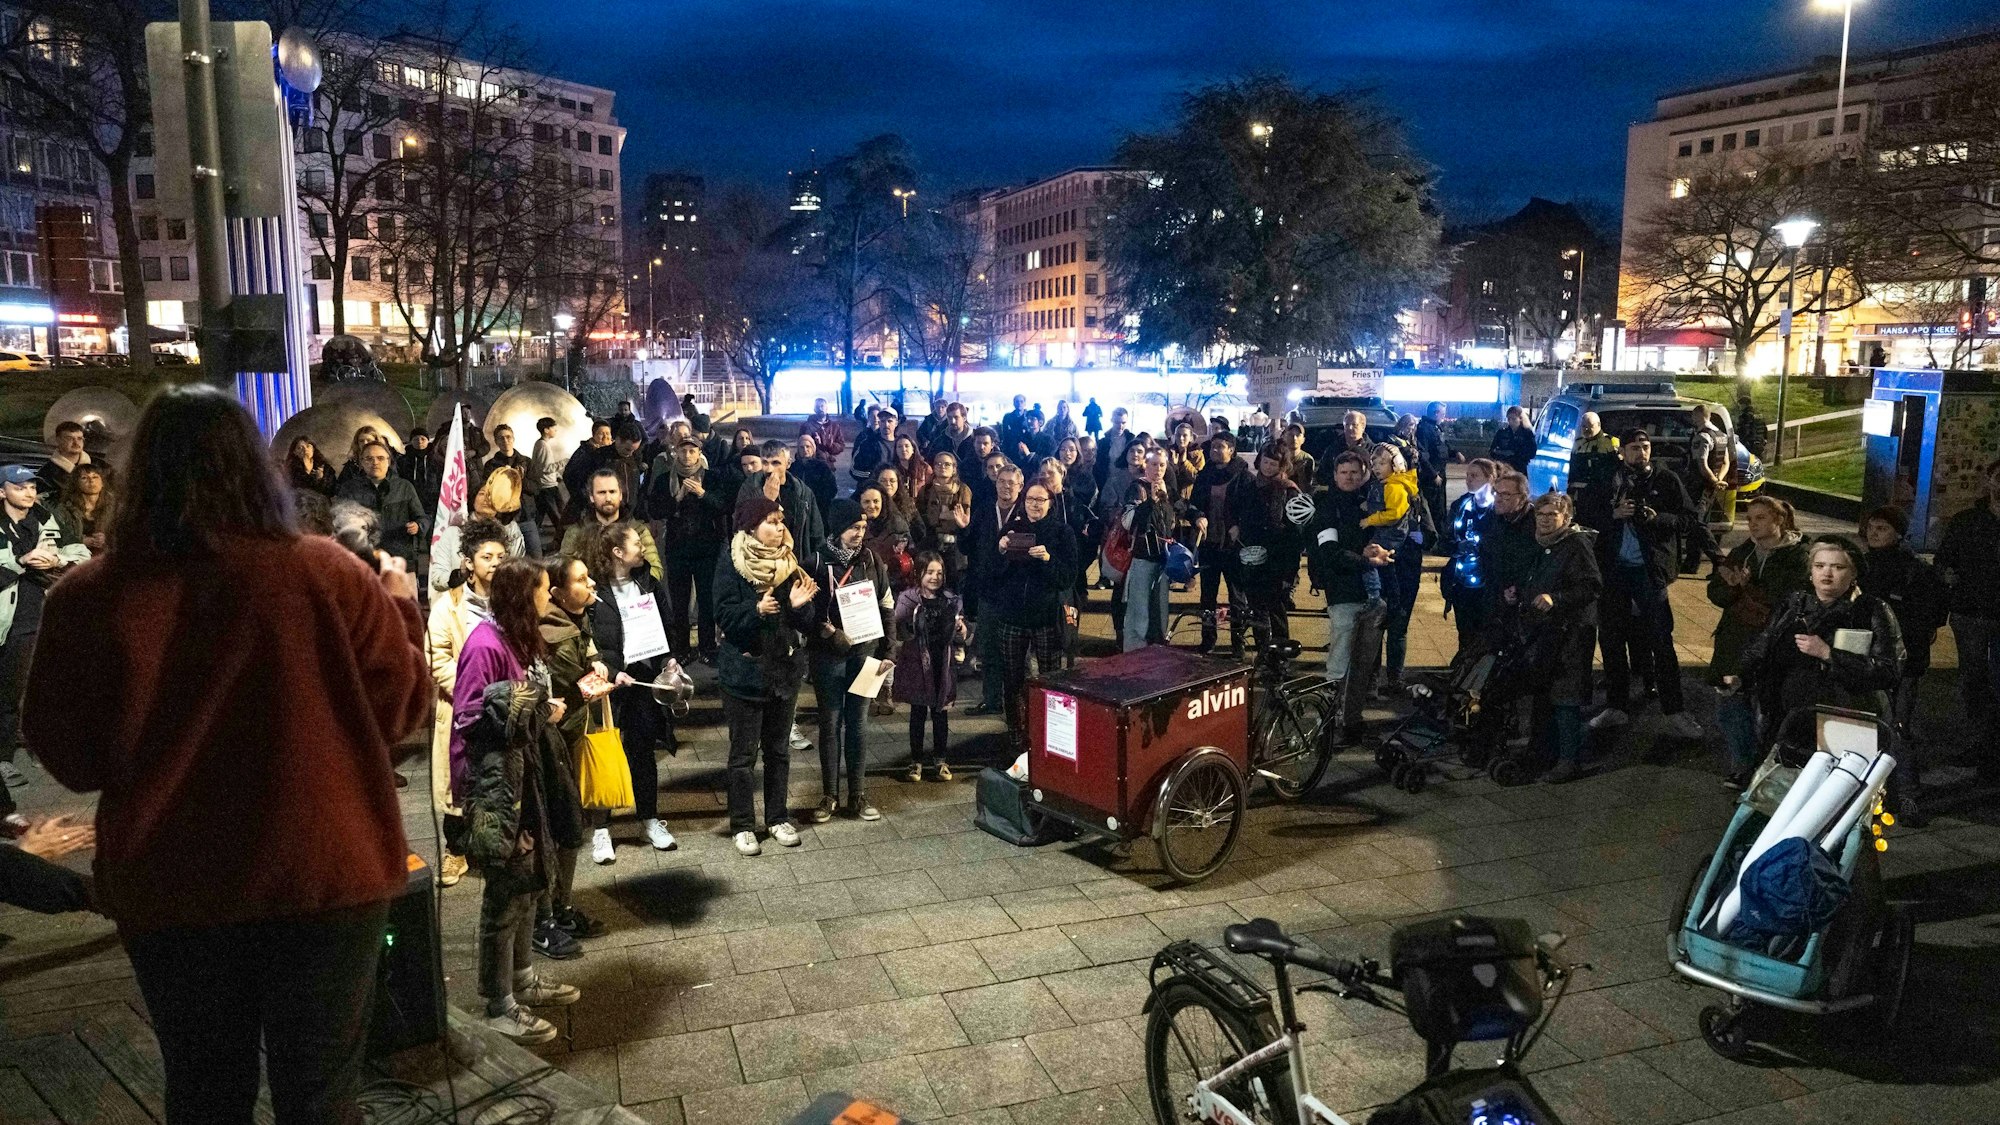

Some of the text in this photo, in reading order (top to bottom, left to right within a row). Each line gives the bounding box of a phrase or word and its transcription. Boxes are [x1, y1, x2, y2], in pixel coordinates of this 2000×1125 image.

[1880, 325, 1956, 334] HANSA APOHEKE
[1352, 370, 1383, 378] Fries TV
[1187, 684, 1245, 720] alvin
